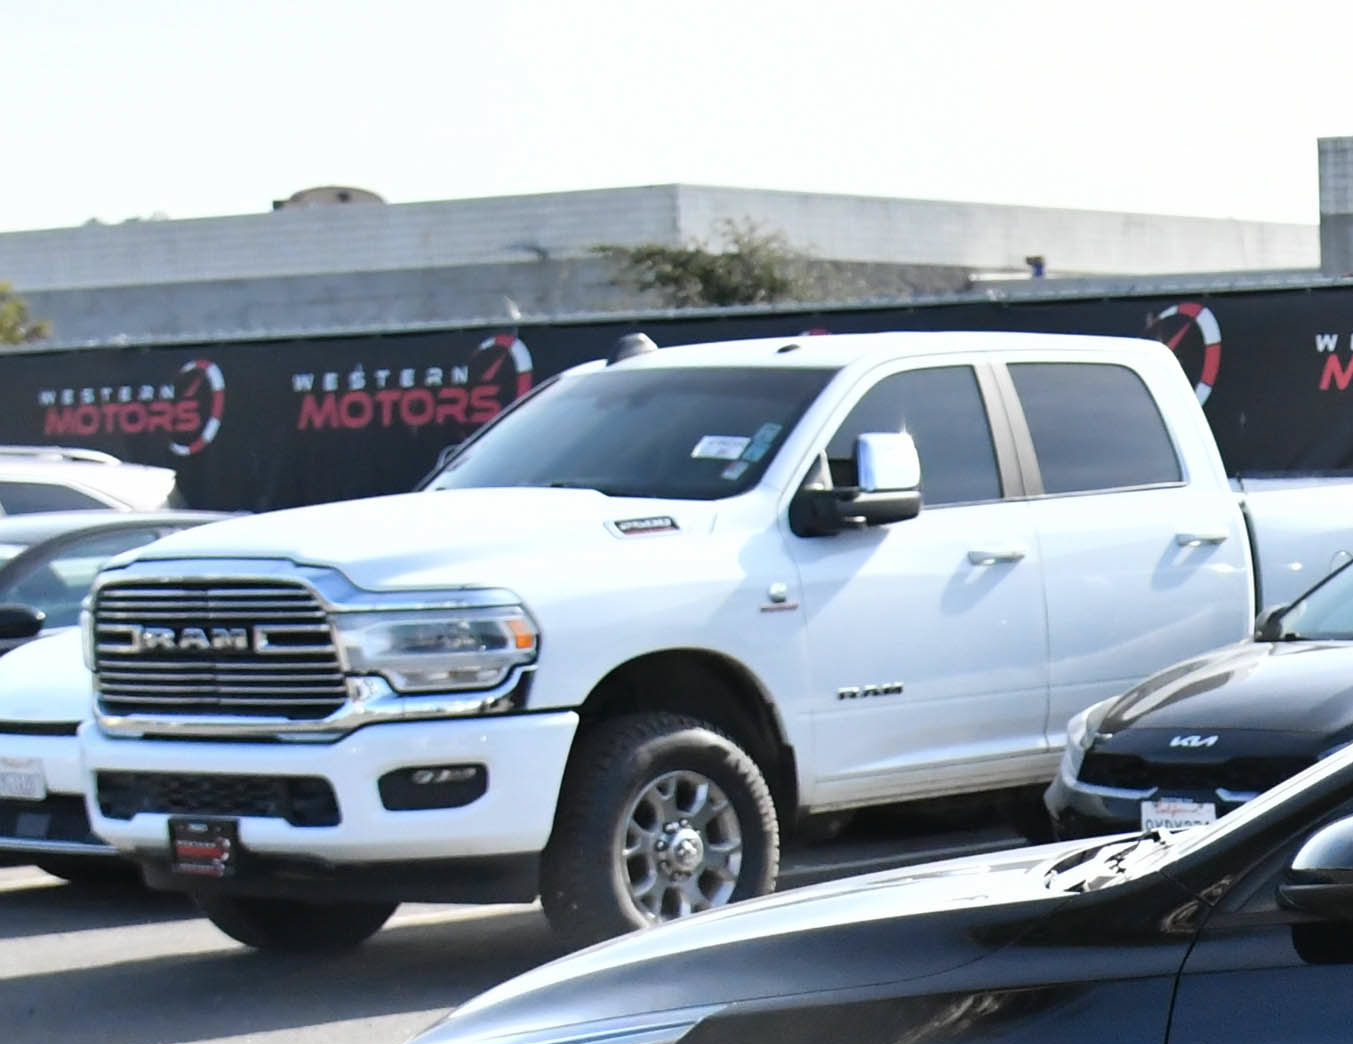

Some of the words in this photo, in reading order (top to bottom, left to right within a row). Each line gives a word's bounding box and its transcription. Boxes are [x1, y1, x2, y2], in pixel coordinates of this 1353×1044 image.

[292, 365, 469, 392] WESTERN
[39, 384, 176, 405] WESTERN
[44, 401, 201, 436] MOTORS
[299, 385, 502, 430] MOTORS
[142, 626, 249, 649] RAM
[837, 681, 904, 700] RAM
